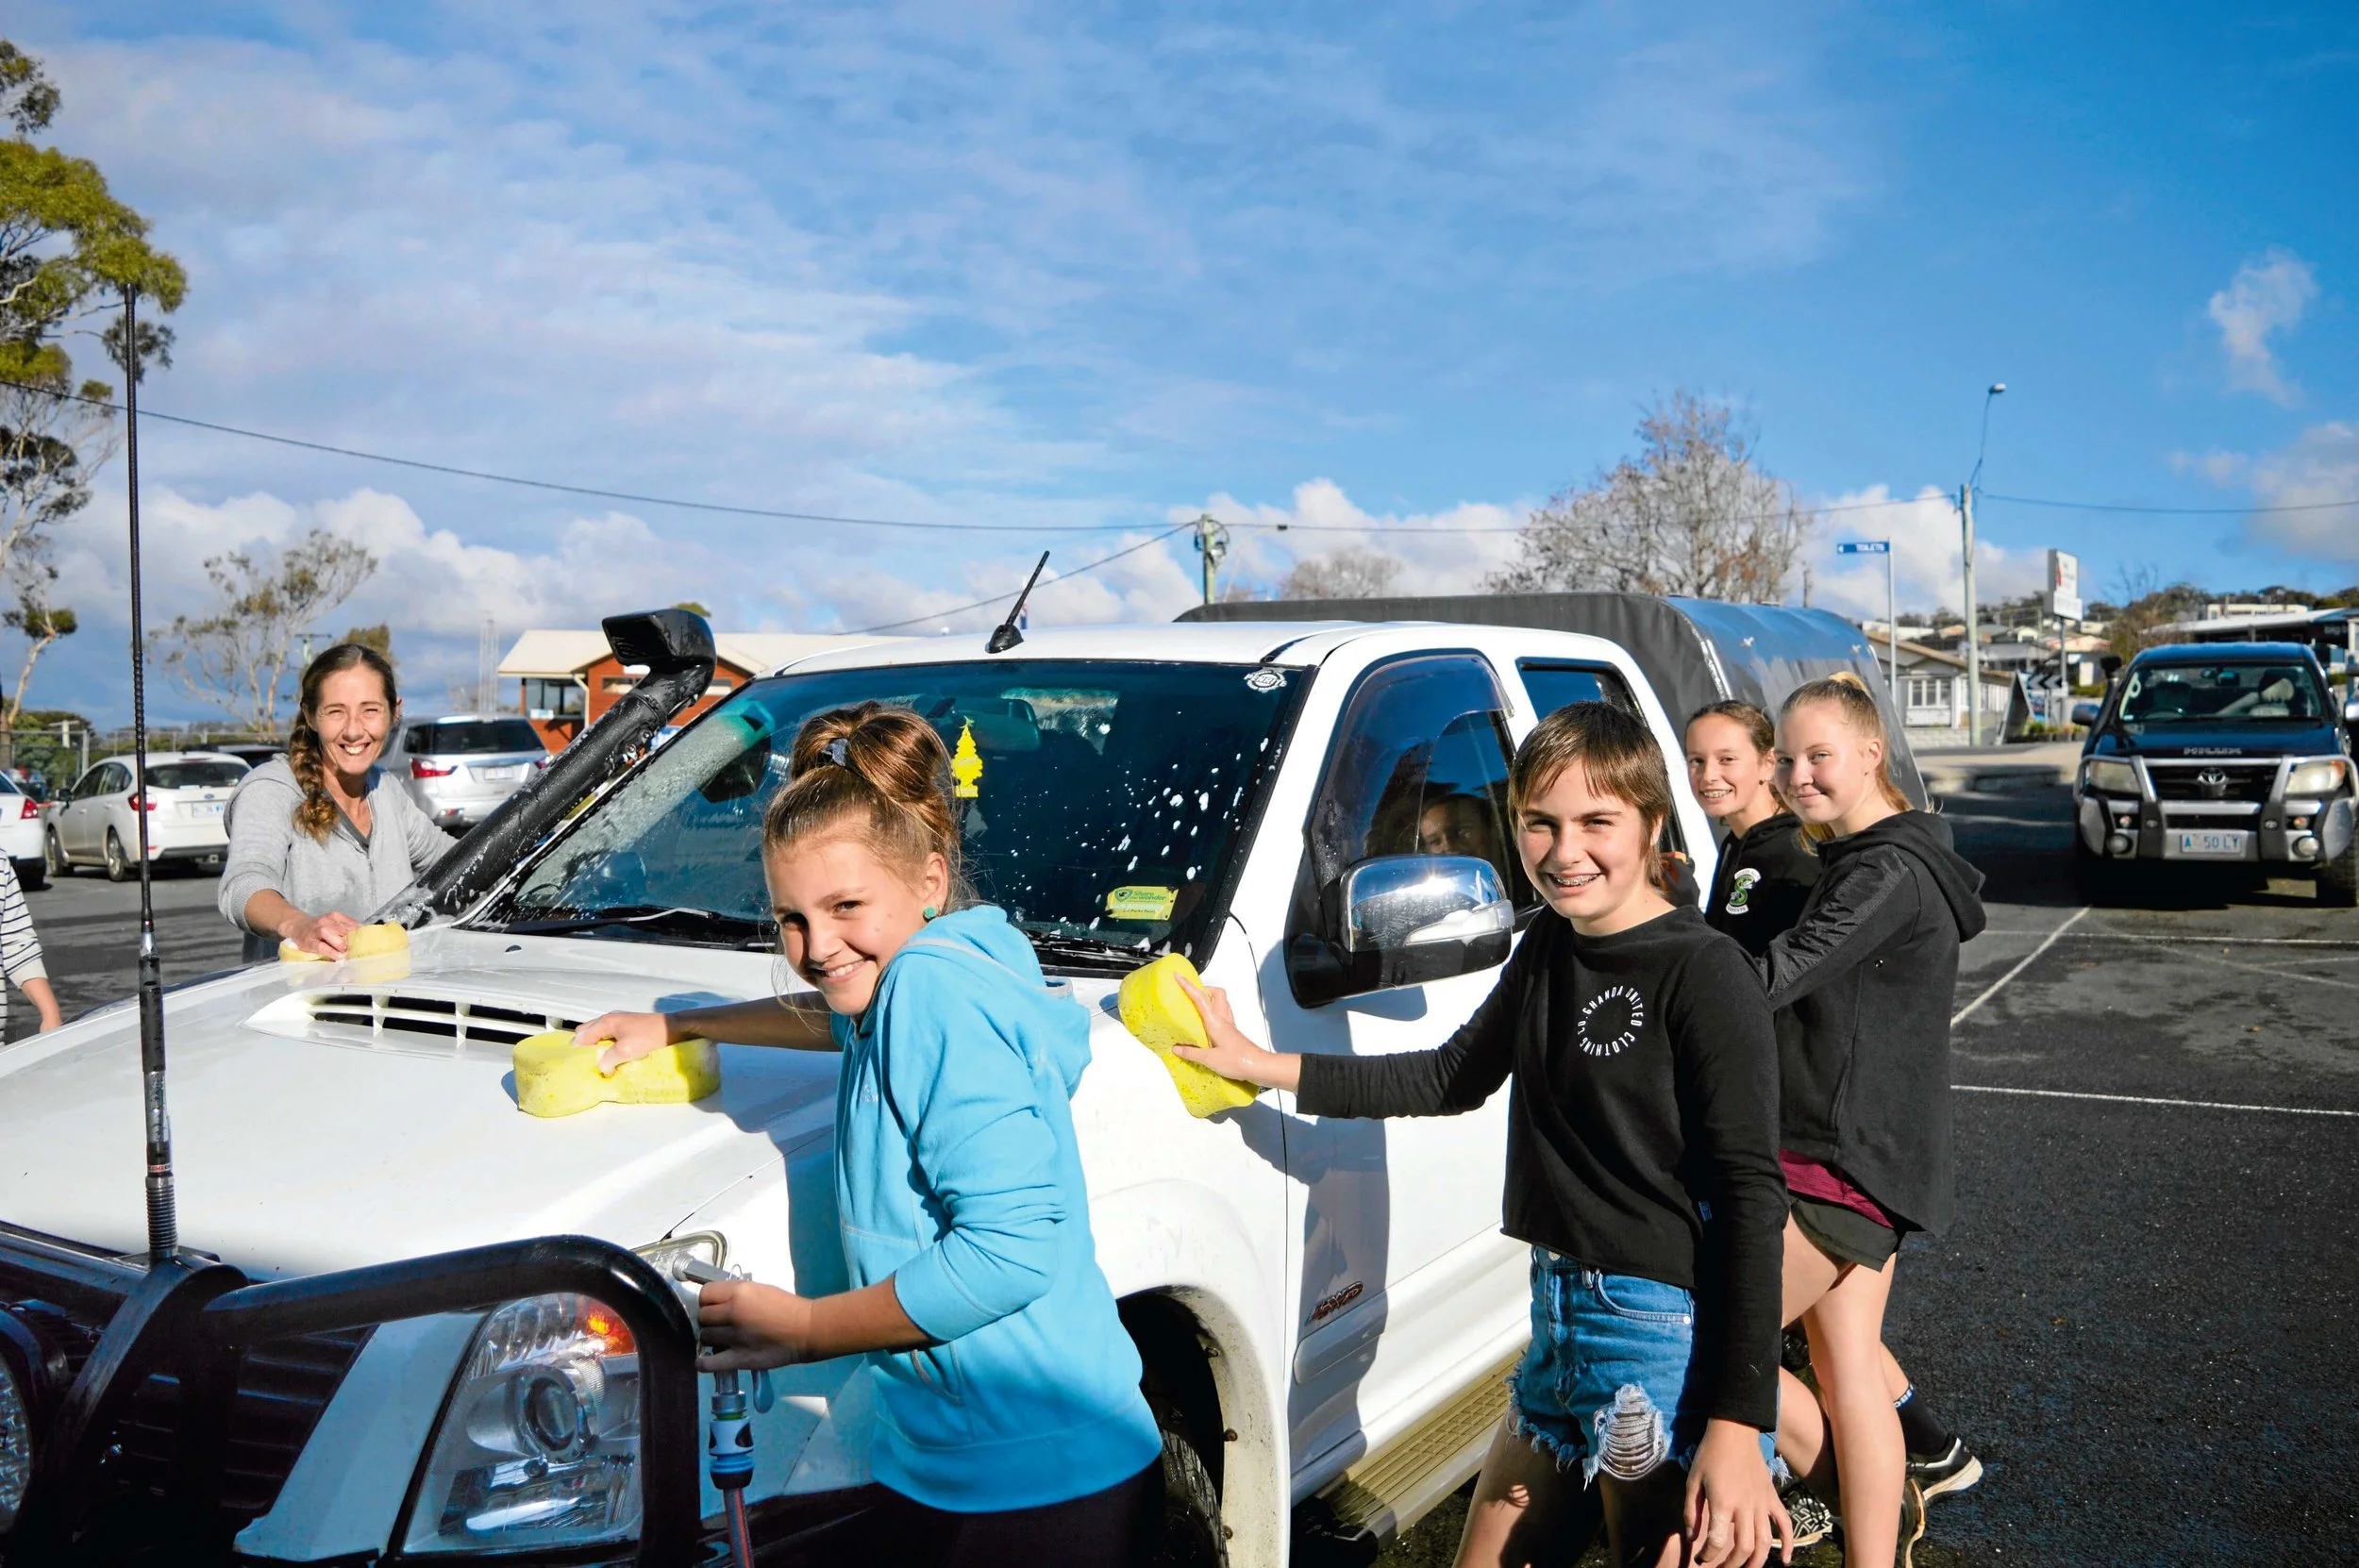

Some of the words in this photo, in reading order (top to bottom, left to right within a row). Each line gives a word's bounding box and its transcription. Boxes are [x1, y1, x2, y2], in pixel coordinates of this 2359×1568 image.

[1582, 985, 1624, 1015] GHANDA
[1625, 987, 1644, 1027] UNITED
[1579, 1031, 1635, 1057] CLOTHING
